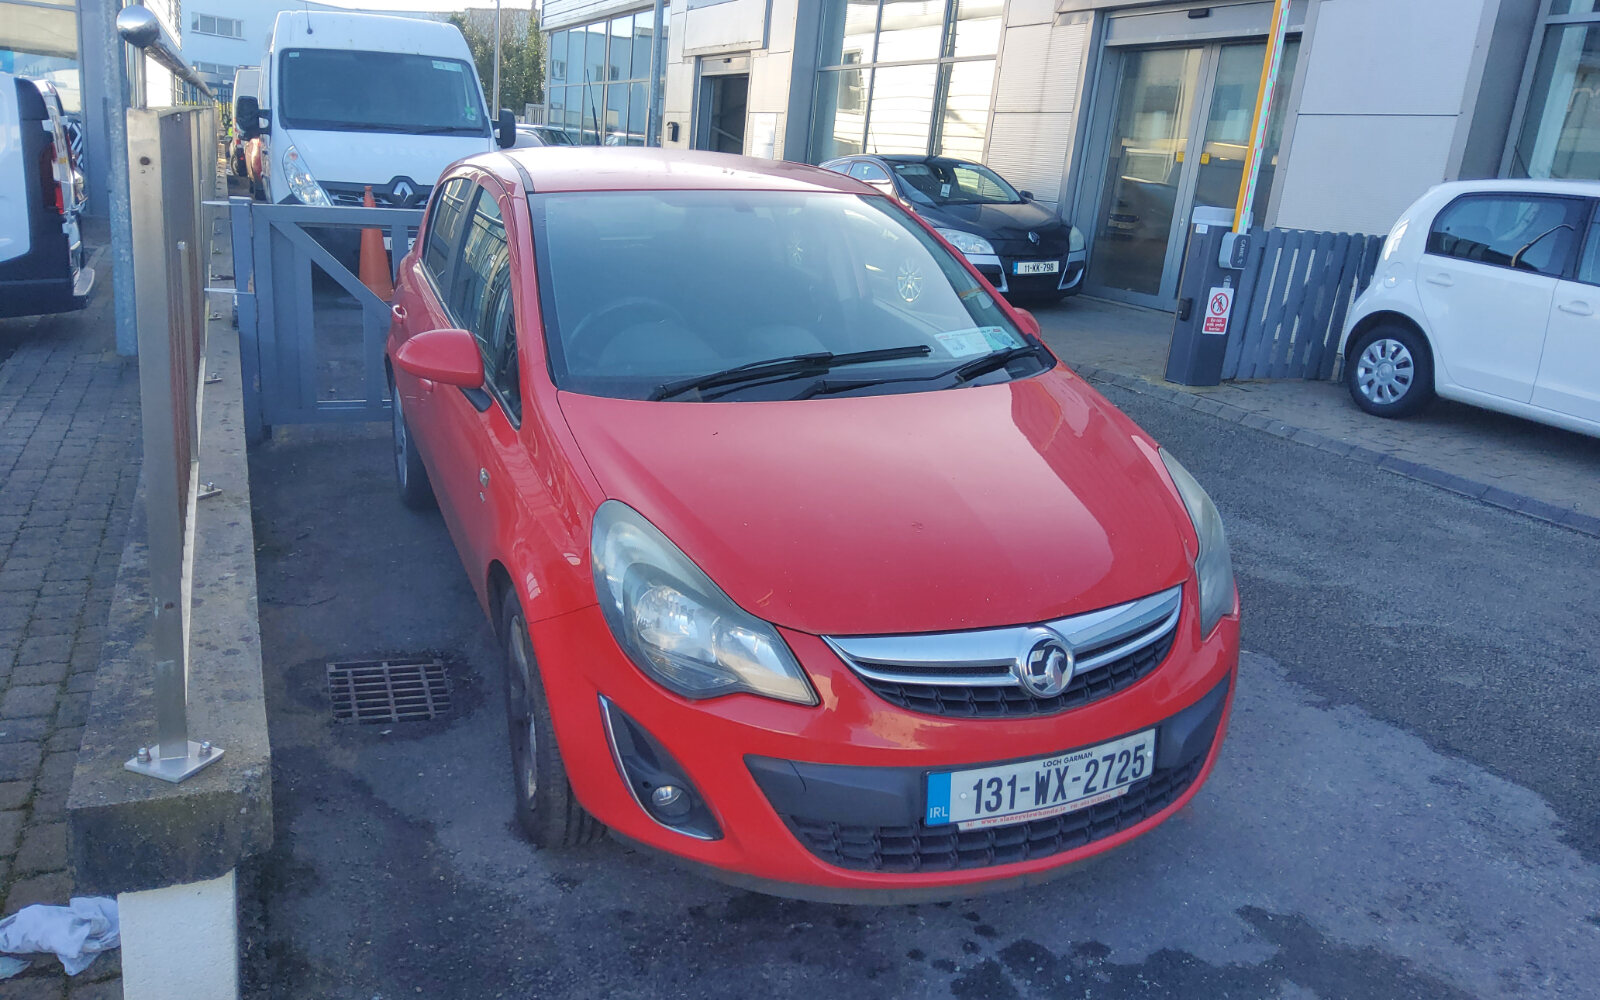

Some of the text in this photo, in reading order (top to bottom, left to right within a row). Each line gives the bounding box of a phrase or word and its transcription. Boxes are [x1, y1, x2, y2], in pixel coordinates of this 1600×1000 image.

[1024, 263, 1054, 272] 11-KK-798
[1043, 751, 1093, 768] LOCH GARMAN
[973, 744, 1146, 815] 131-WX-2725
[929, 806, 948, 818] IRL
